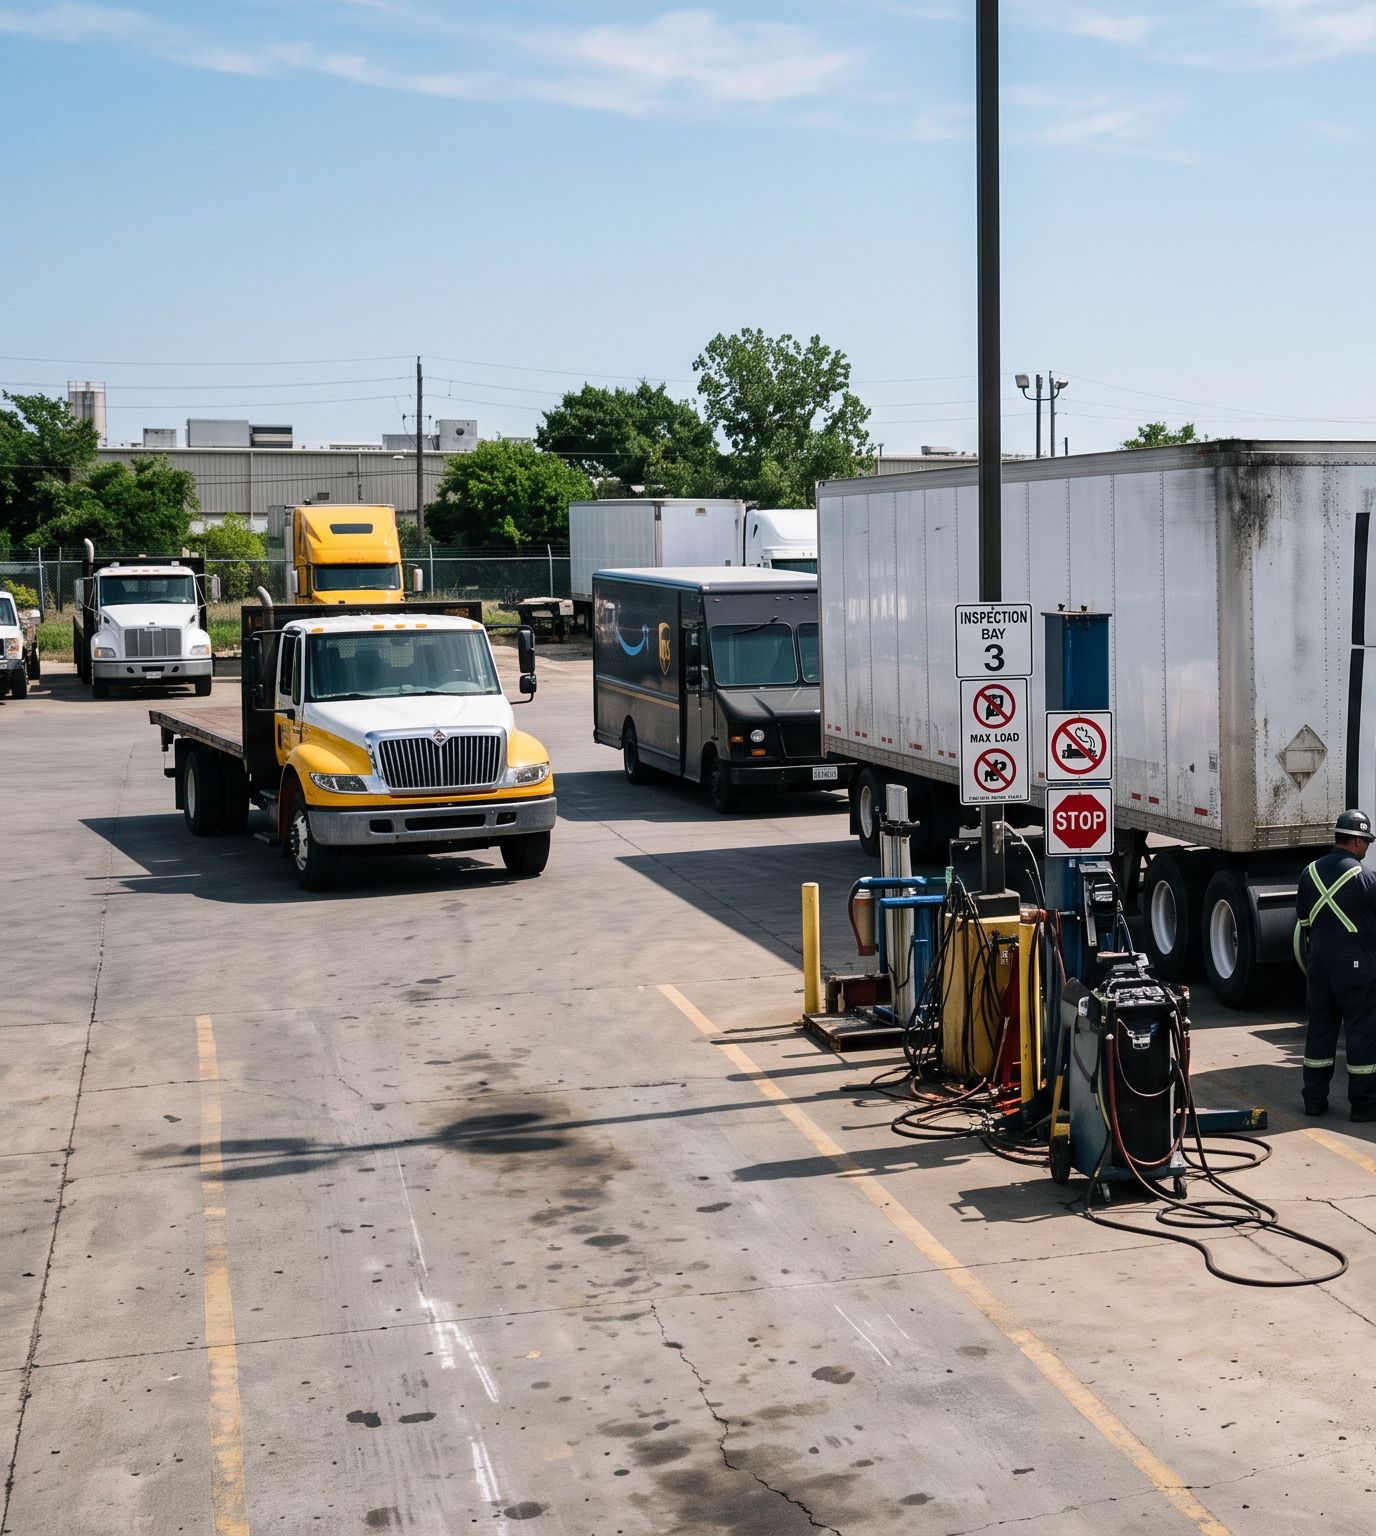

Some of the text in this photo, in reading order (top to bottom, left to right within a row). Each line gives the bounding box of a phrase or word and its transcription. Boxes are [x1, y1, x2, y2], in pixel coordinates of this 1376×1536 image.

[960, 610, 1027, 625] INSPECTION
[981, 628, 1006, 640] BAY
[984, 643, 1005, 672] 3
[970, 732, 1020, 743] MAX LOAD
[1056, 811, 1104, 830] STOP
